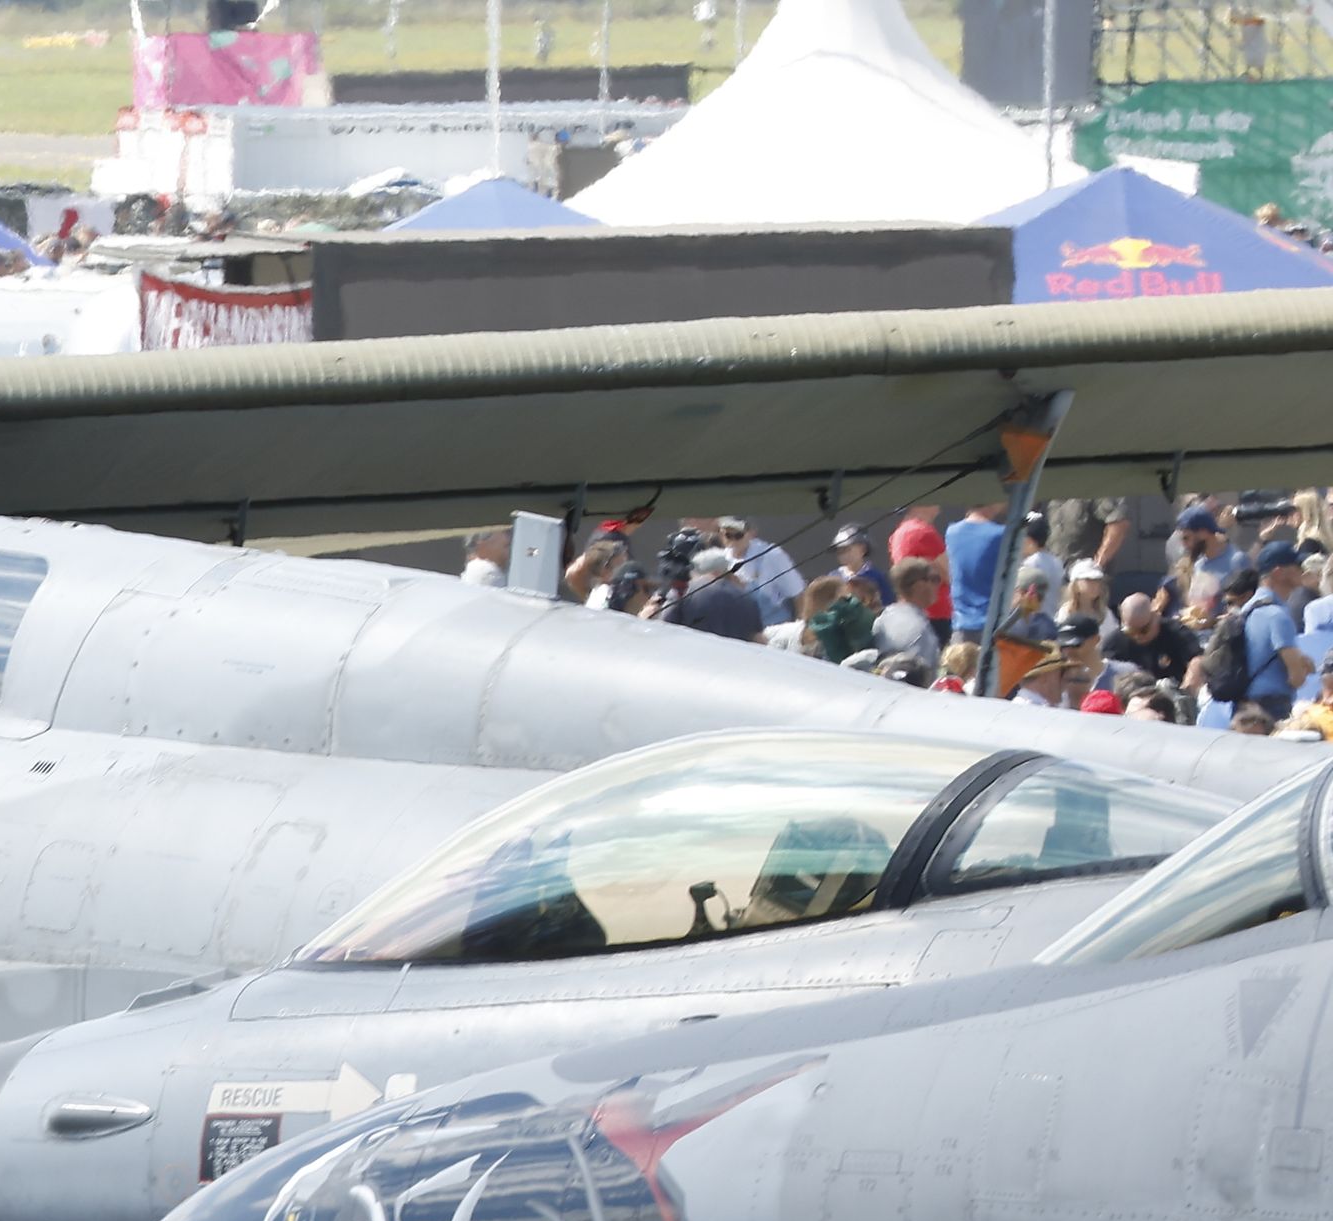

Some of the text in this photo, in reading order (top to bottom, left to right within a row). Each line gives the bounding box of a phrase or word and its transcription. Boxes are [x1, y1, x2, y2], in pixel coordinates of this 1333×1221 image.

[1046, 271, 1222, 297] Red Bull
[219, 1086, 285, 1108] RESCUE
